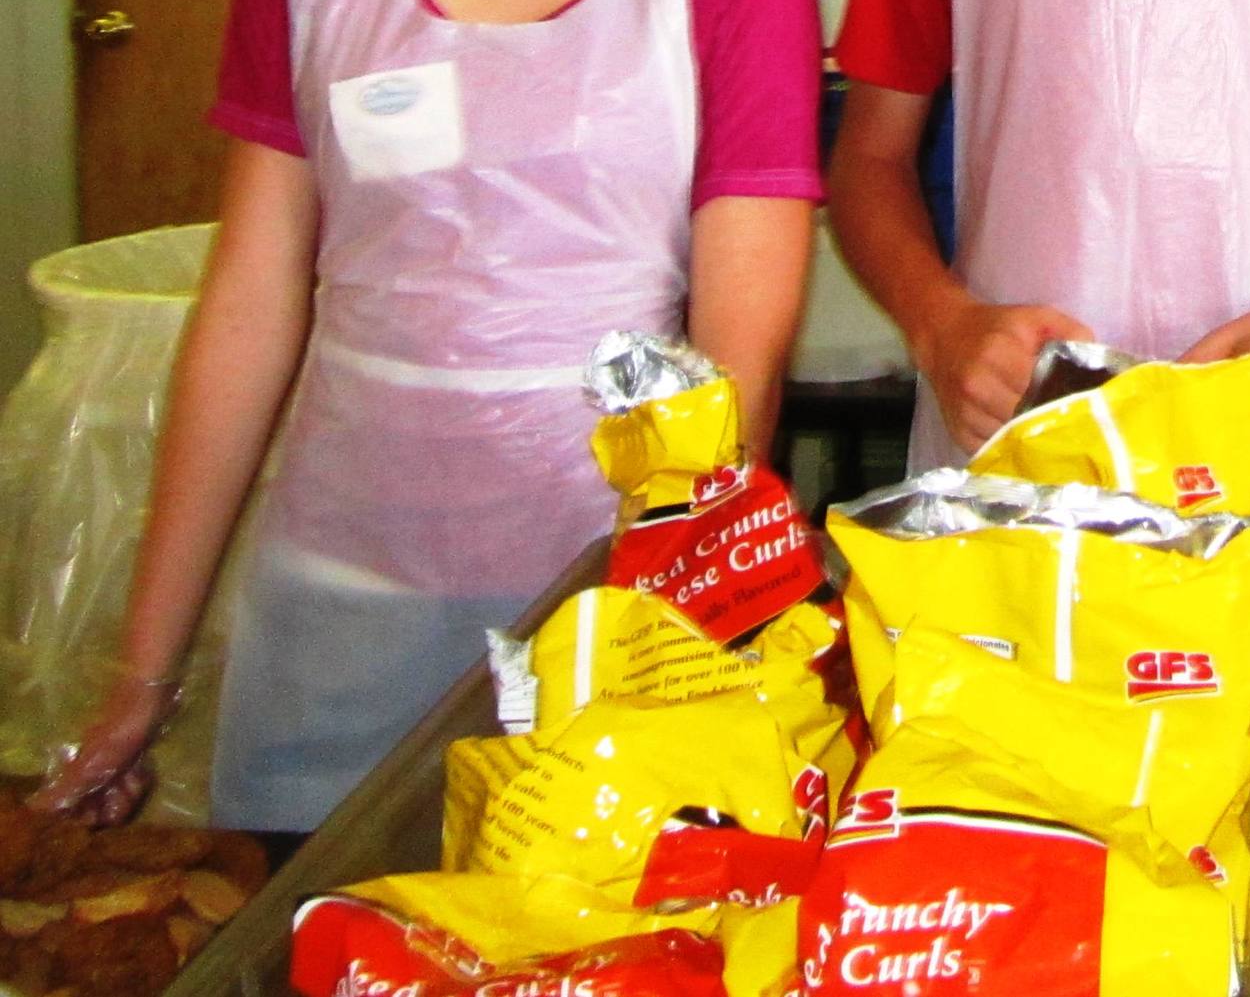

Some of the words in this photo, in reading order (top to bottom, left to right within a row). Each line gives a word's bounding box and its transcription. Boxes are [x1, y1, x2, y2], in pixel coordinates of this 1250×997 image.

[728, 521, 807, 573] Curls
[1126, 651, 1214, 682] GFS
[840, 936, 962, 986] Curls
